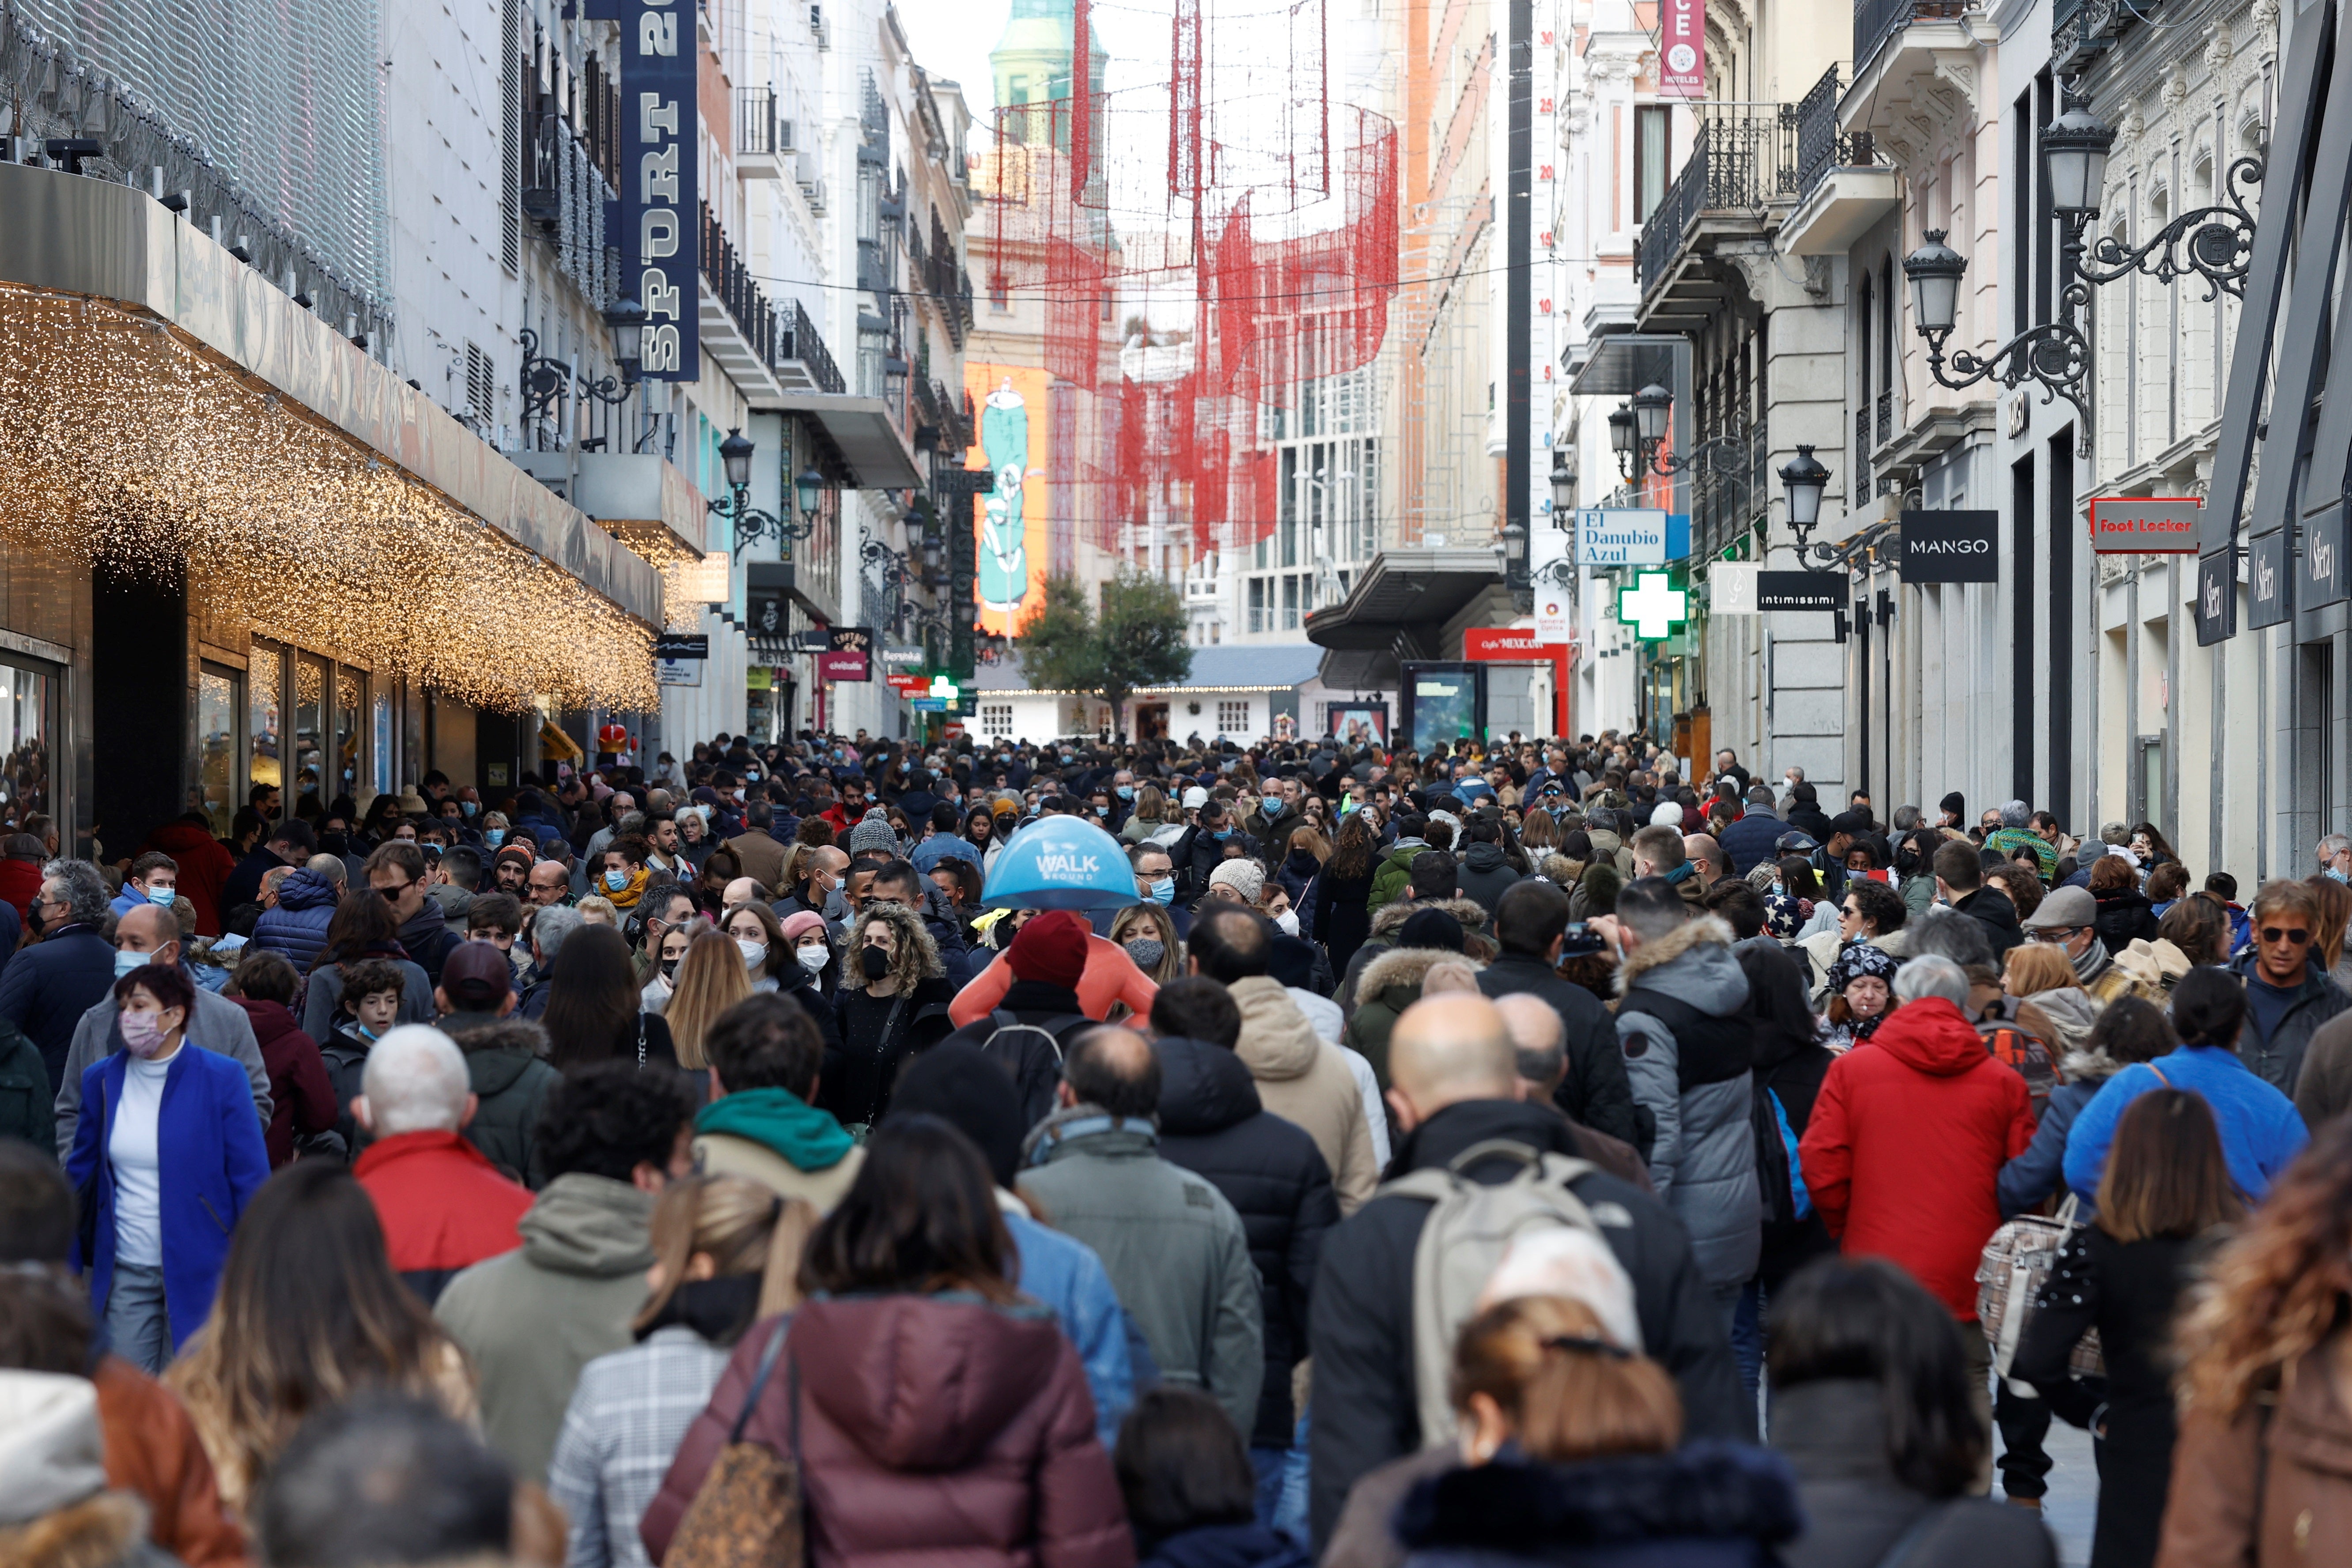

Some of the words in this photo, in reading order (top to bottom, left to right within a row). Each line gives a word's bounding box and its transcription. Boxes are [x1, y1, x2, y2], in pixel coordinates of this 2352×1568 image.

[1541, 32, 1553, 44] 30
[1664, 75, 1699, 84] HOTELES
[1540, 98, 1553, 112] 25
[1540, 165, 1553, 178] 20
[640, 92, 680, 372] SPORT
[1540, 232, 1552, 246] 15
[1539, 299, 1551, 313] 10
[1545, 365, 1551, 379] 5
[1544, 432, 1551, 446] 0
[1585, 513, 1604, 527] El
[2101, 519, 2134, 533] Foot
[2139, 518, 2192, 533] Locker
[1585, 530, 1658, 544] Danubio
[1911, 539, 1989, 554] MANGO
[1585, 547, 1626, 561] Azul
[1761, 595, 1834, 605] intimissimi
[758, 651, 793, 663] REYES
[883, 648, 922, 662] Bershka
[1036, 854, 1100, 873] WALK
